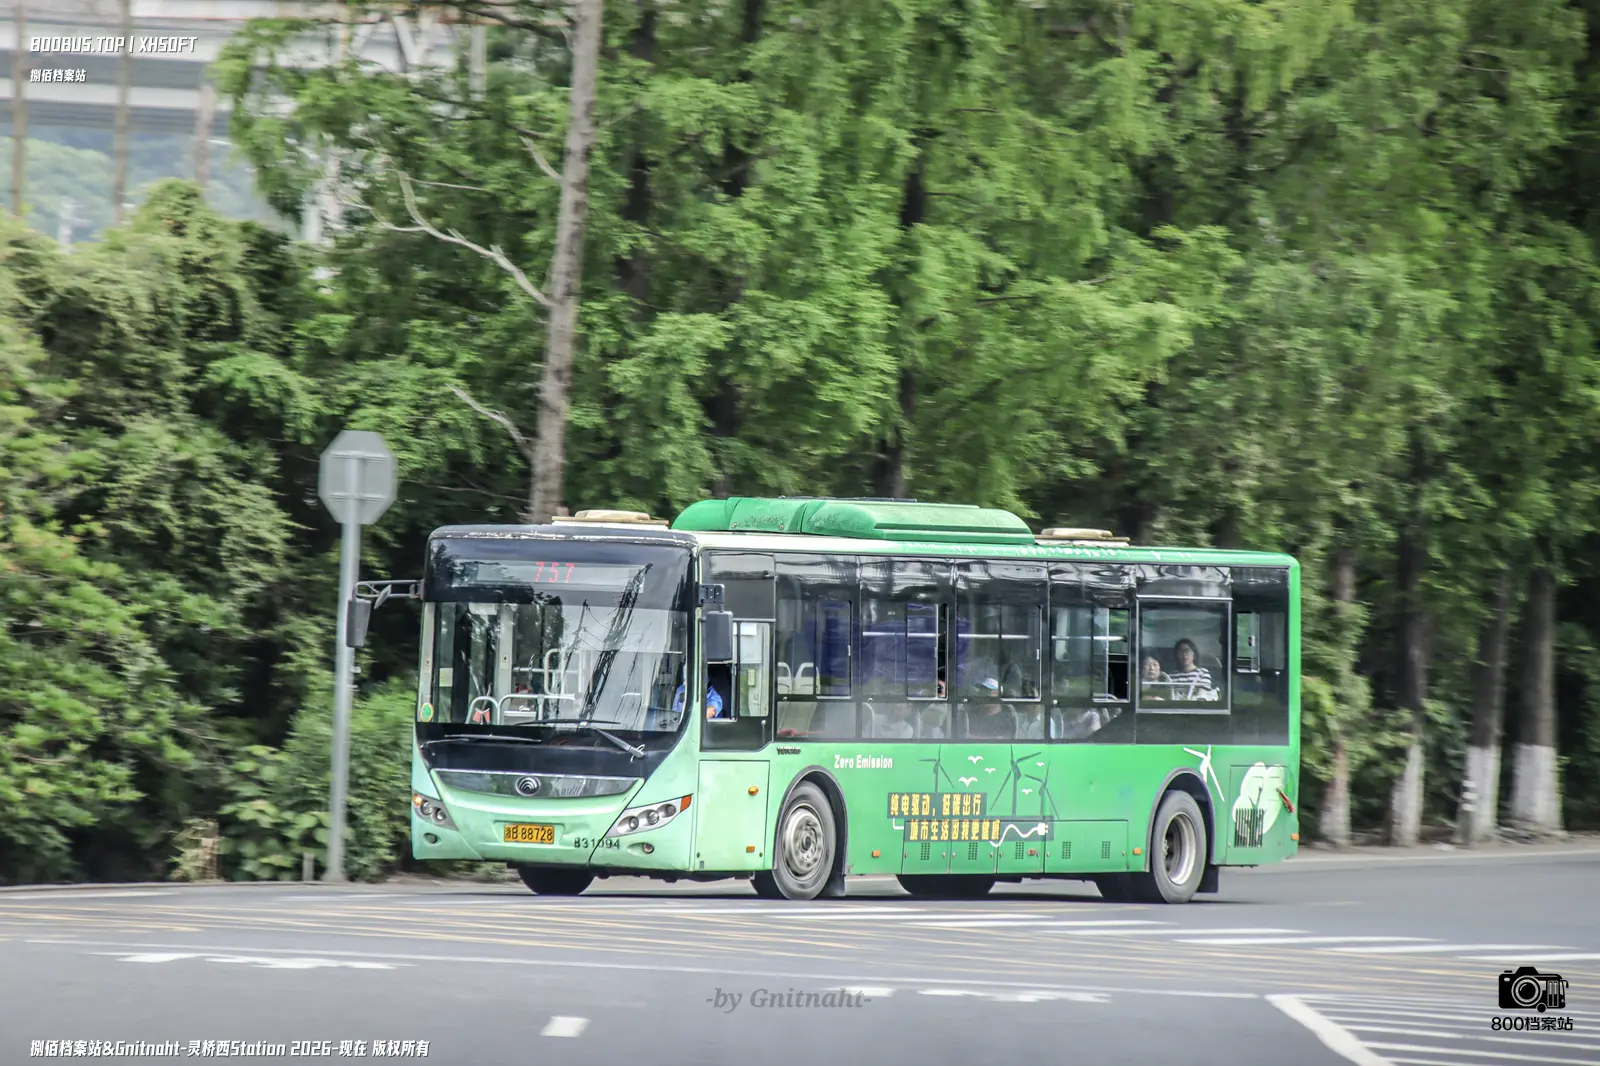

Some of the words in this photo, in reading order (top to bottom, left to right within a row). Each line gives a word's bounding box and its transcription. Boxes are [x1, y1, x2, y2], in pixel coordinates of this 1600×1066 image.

[535, 561, 576, 584] 757
[834, 754, 854, 769] Zero
[856, 754, 893, 769] Emission
